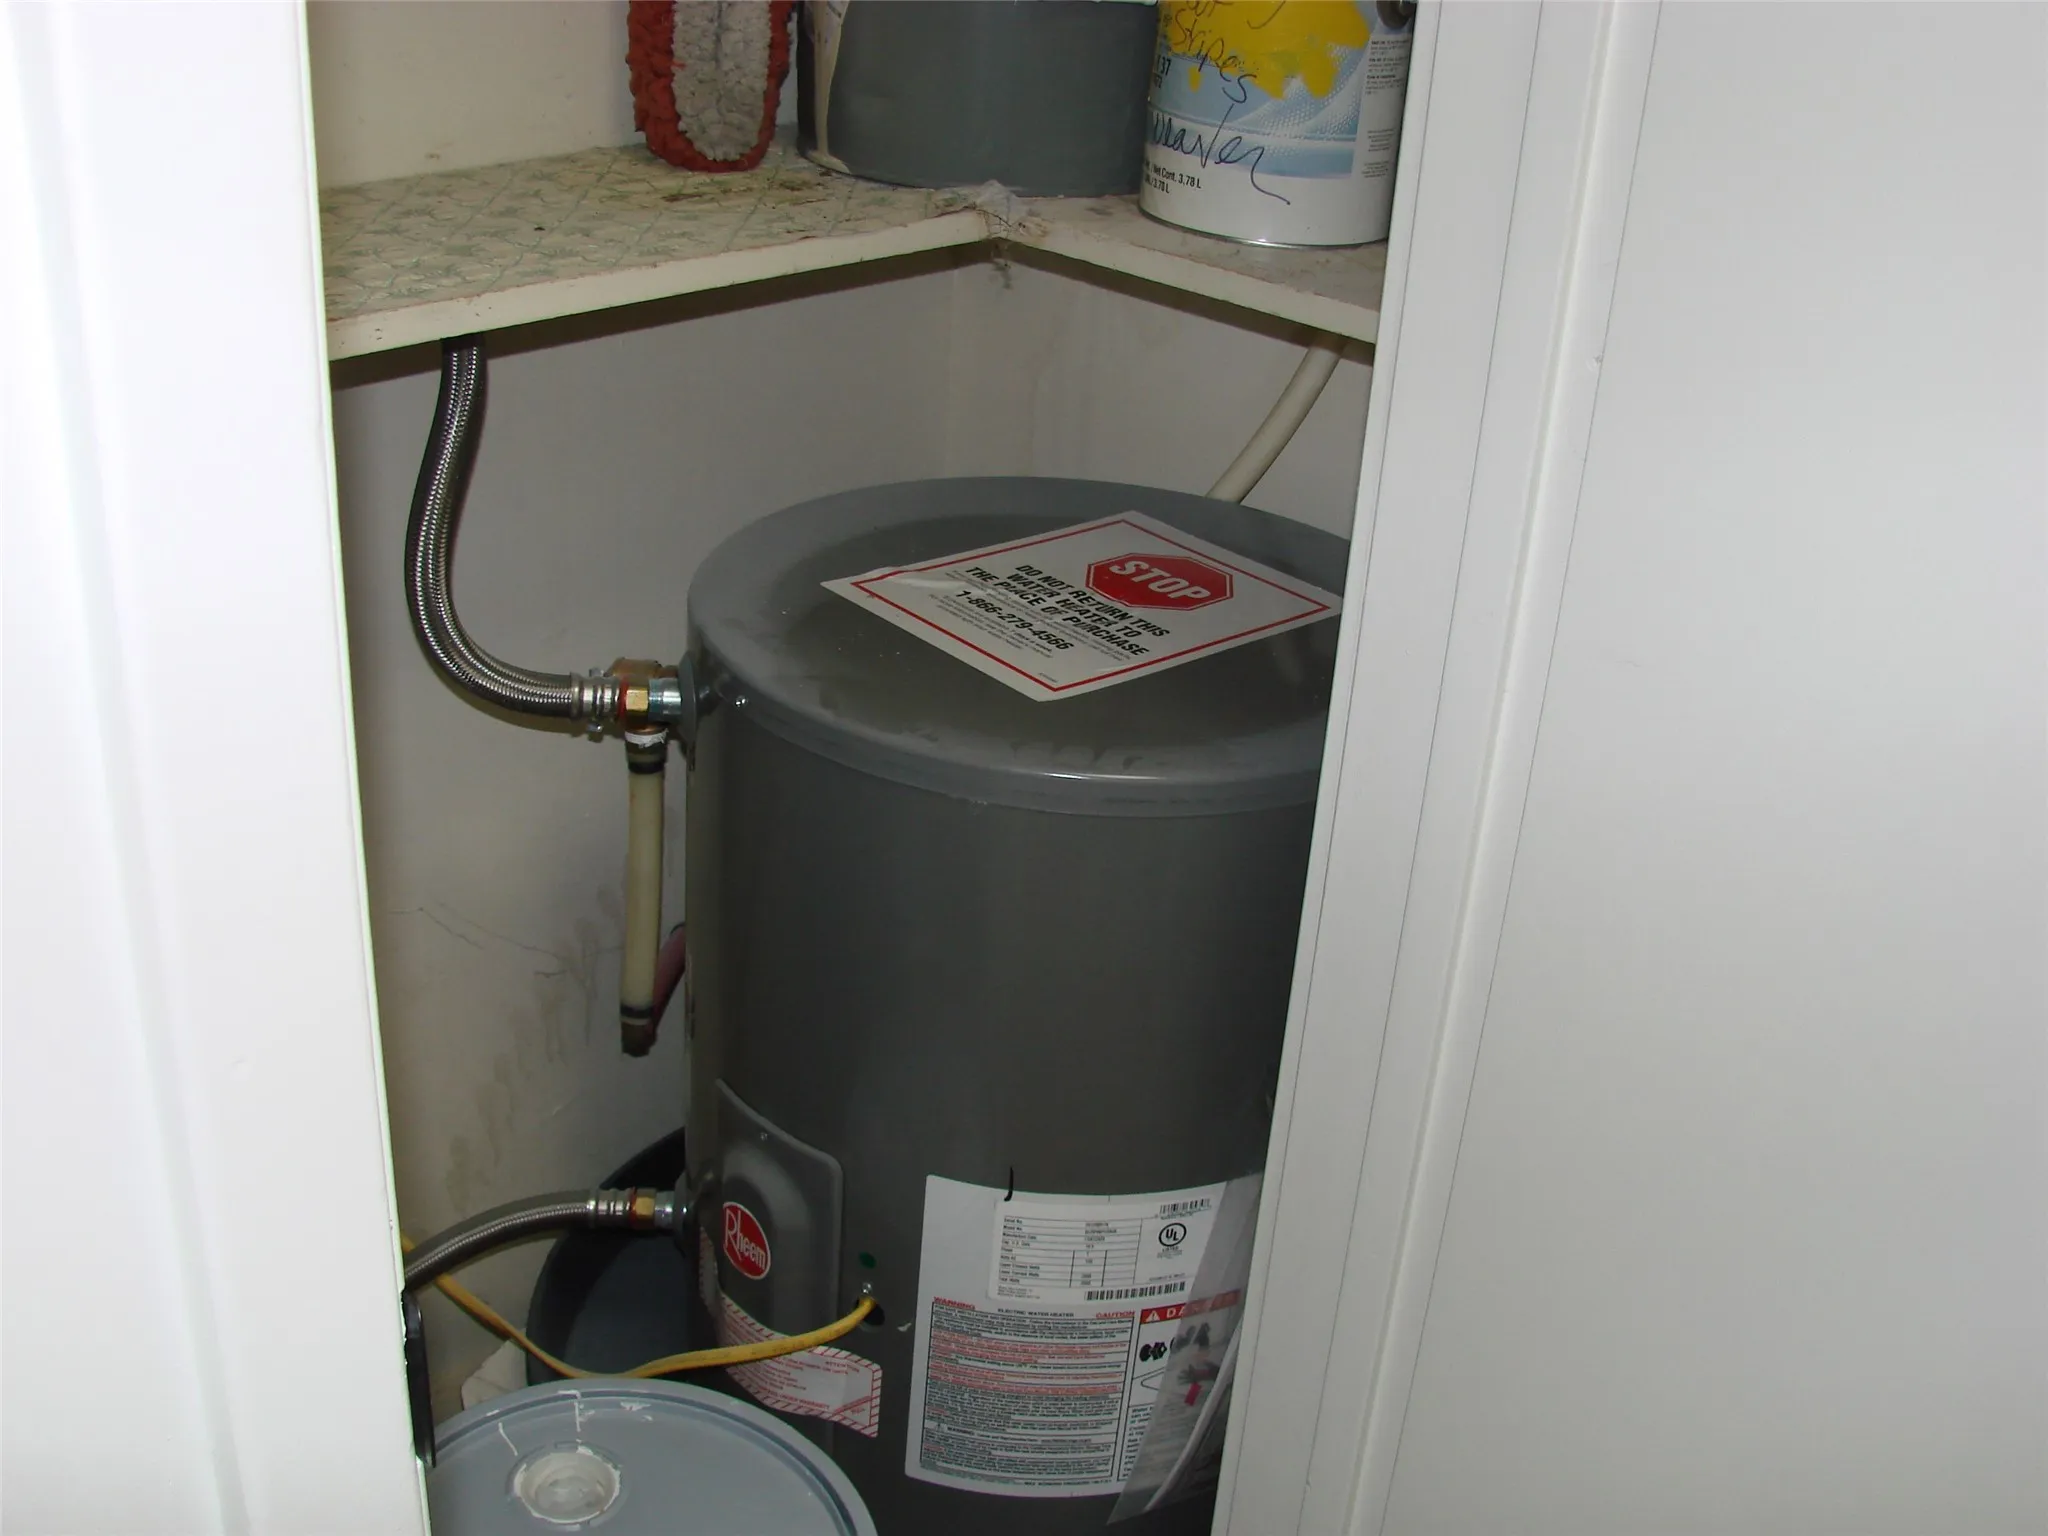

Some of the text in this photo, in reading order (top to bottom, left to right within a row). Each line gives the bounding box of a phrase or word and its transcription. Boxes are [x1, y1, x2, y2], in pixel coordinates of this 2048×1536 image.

[1006, 573, 1142, 638] WATER HEATER TO
[1015, 565, 1171, 637] DO NOT RETURN THIS
[1109, 560, 1211, 599] STOP
[956, 590, 1075, 650] 1-866-279-4566
[965, 566, 1151, 656] THE PLACE OF PURCHASE
[725, 1207, 767, 1271] Rheem
[1165, 1227, 1180, 1241] UL
[1095, 1310, 1134, 1320] CAUTION
